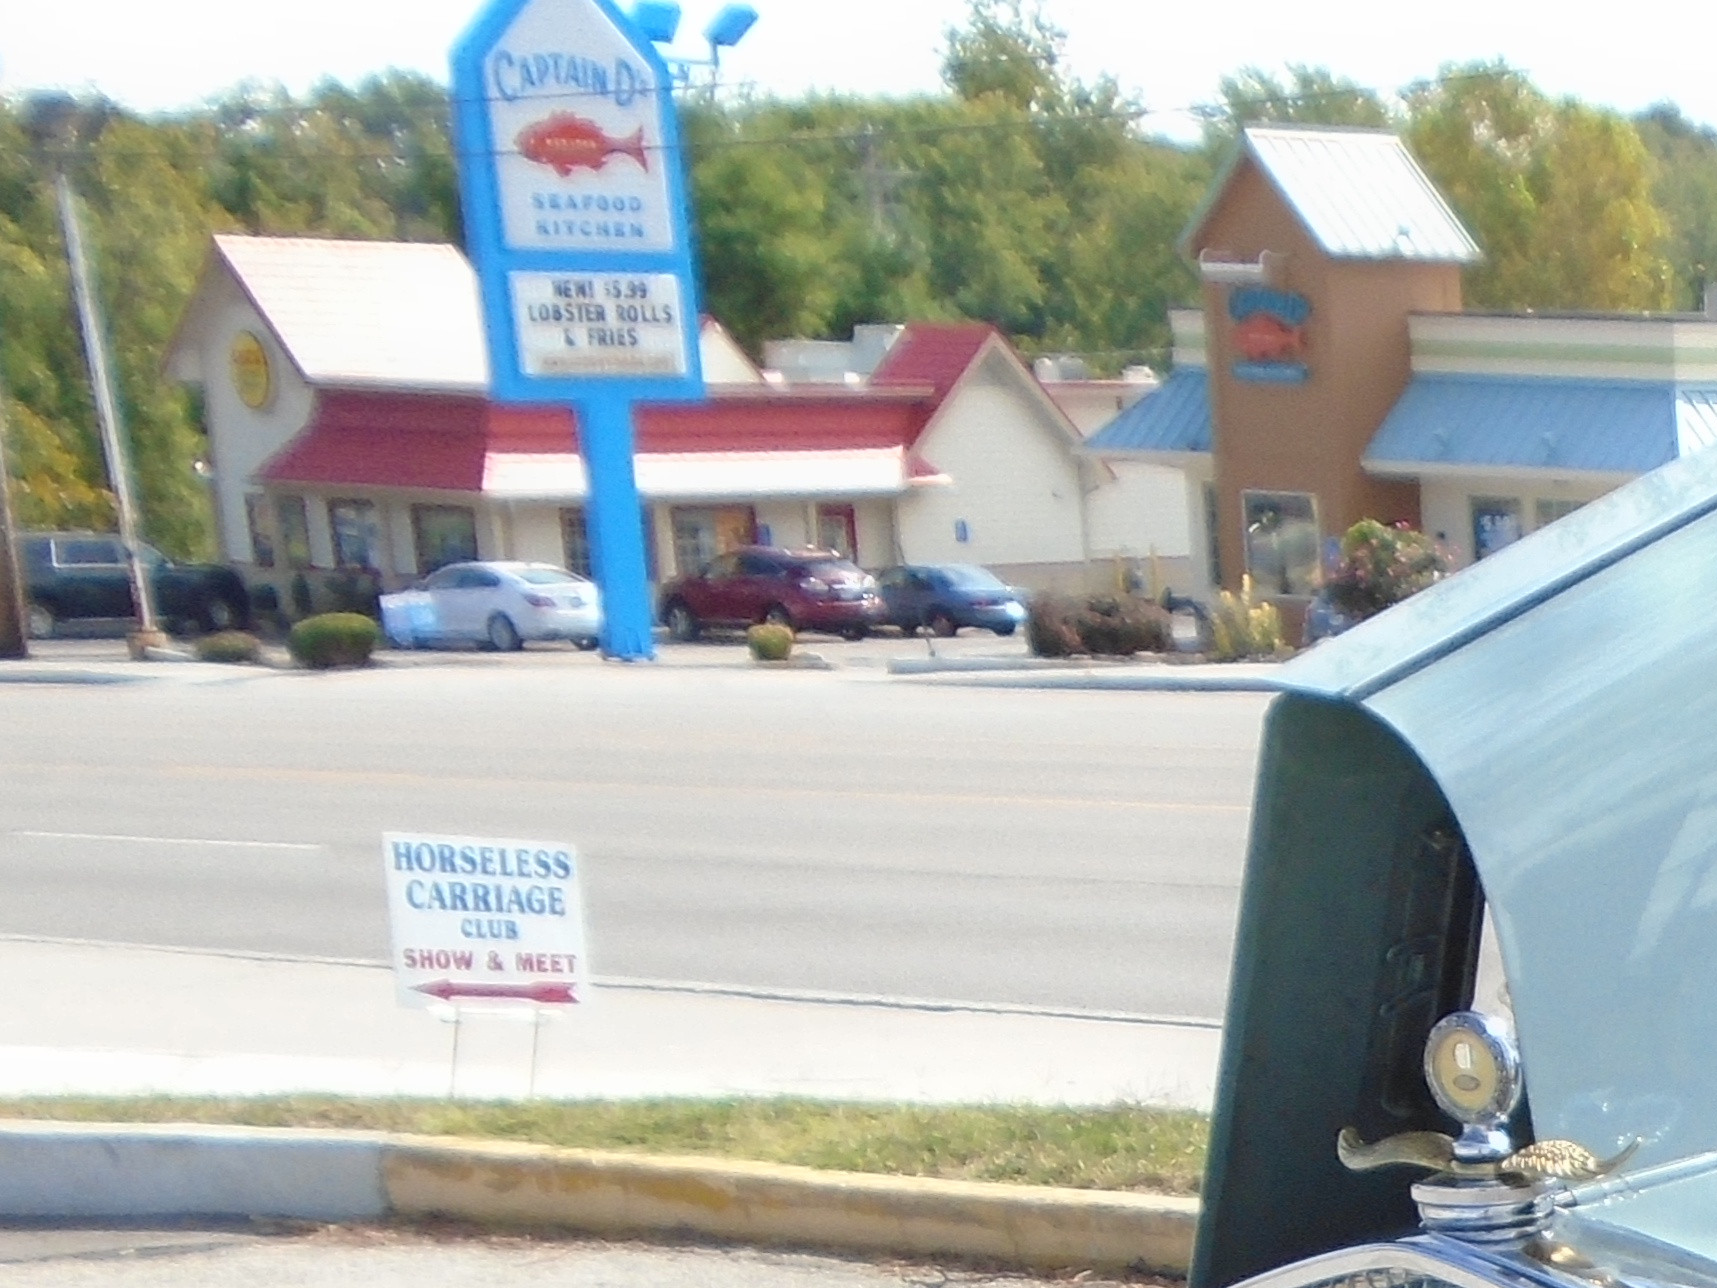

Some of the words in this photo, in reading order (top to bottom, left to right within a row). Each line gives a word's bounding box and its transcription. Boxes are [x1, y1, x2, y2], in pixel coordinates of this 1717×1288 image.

[532, 192, 642, 212] SEAFOOD
[535, 219, 645, 238] KITCHEN
[551, 279, 594, 299] NEW!
[527, 303, 606, 322] LOBSTER
[616, 304, 673, 323] ROLLS
[587, 328, 639, 347] FRIES
[393, 842, 572, 878] HORSELESS
[405, 880, 566, 916] CARRIAGE
[460, 918, 520, 940] CLUB
[402, 947, 474, 971] SHOW
[486, 951, 504, 971] &
[515, 952, 578, 974] MEET
